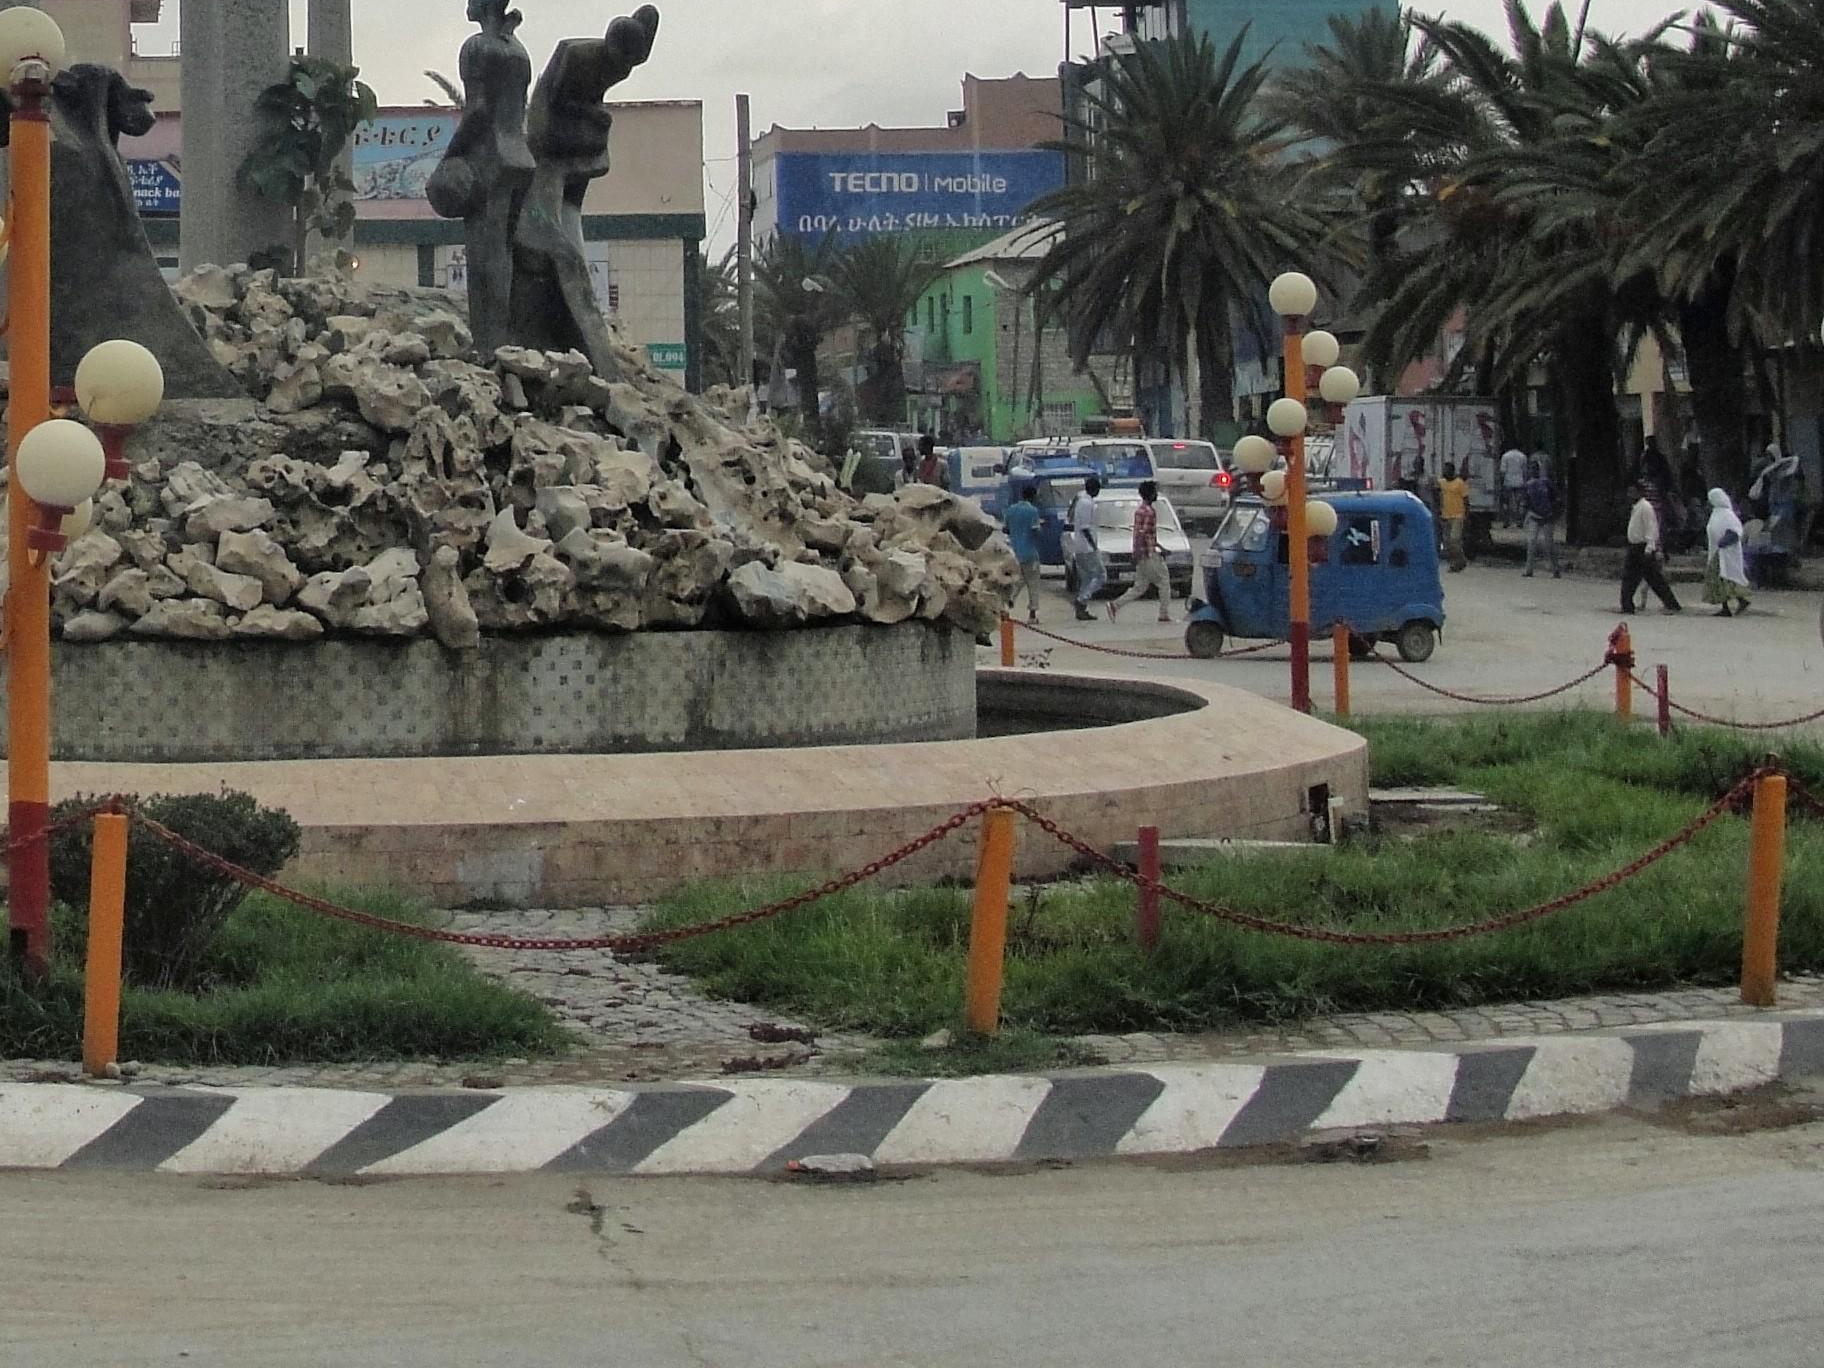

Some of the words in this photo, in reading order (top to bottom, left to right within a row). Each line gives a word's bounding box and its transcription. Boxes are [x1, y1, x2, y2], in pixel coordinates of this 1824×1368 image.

[829, 172, 920, 193] TECNO
[934, 173, 1007, 194] Mobile
[133, 186, 162, 198] nack
[165, 186, 181, 198] ba
